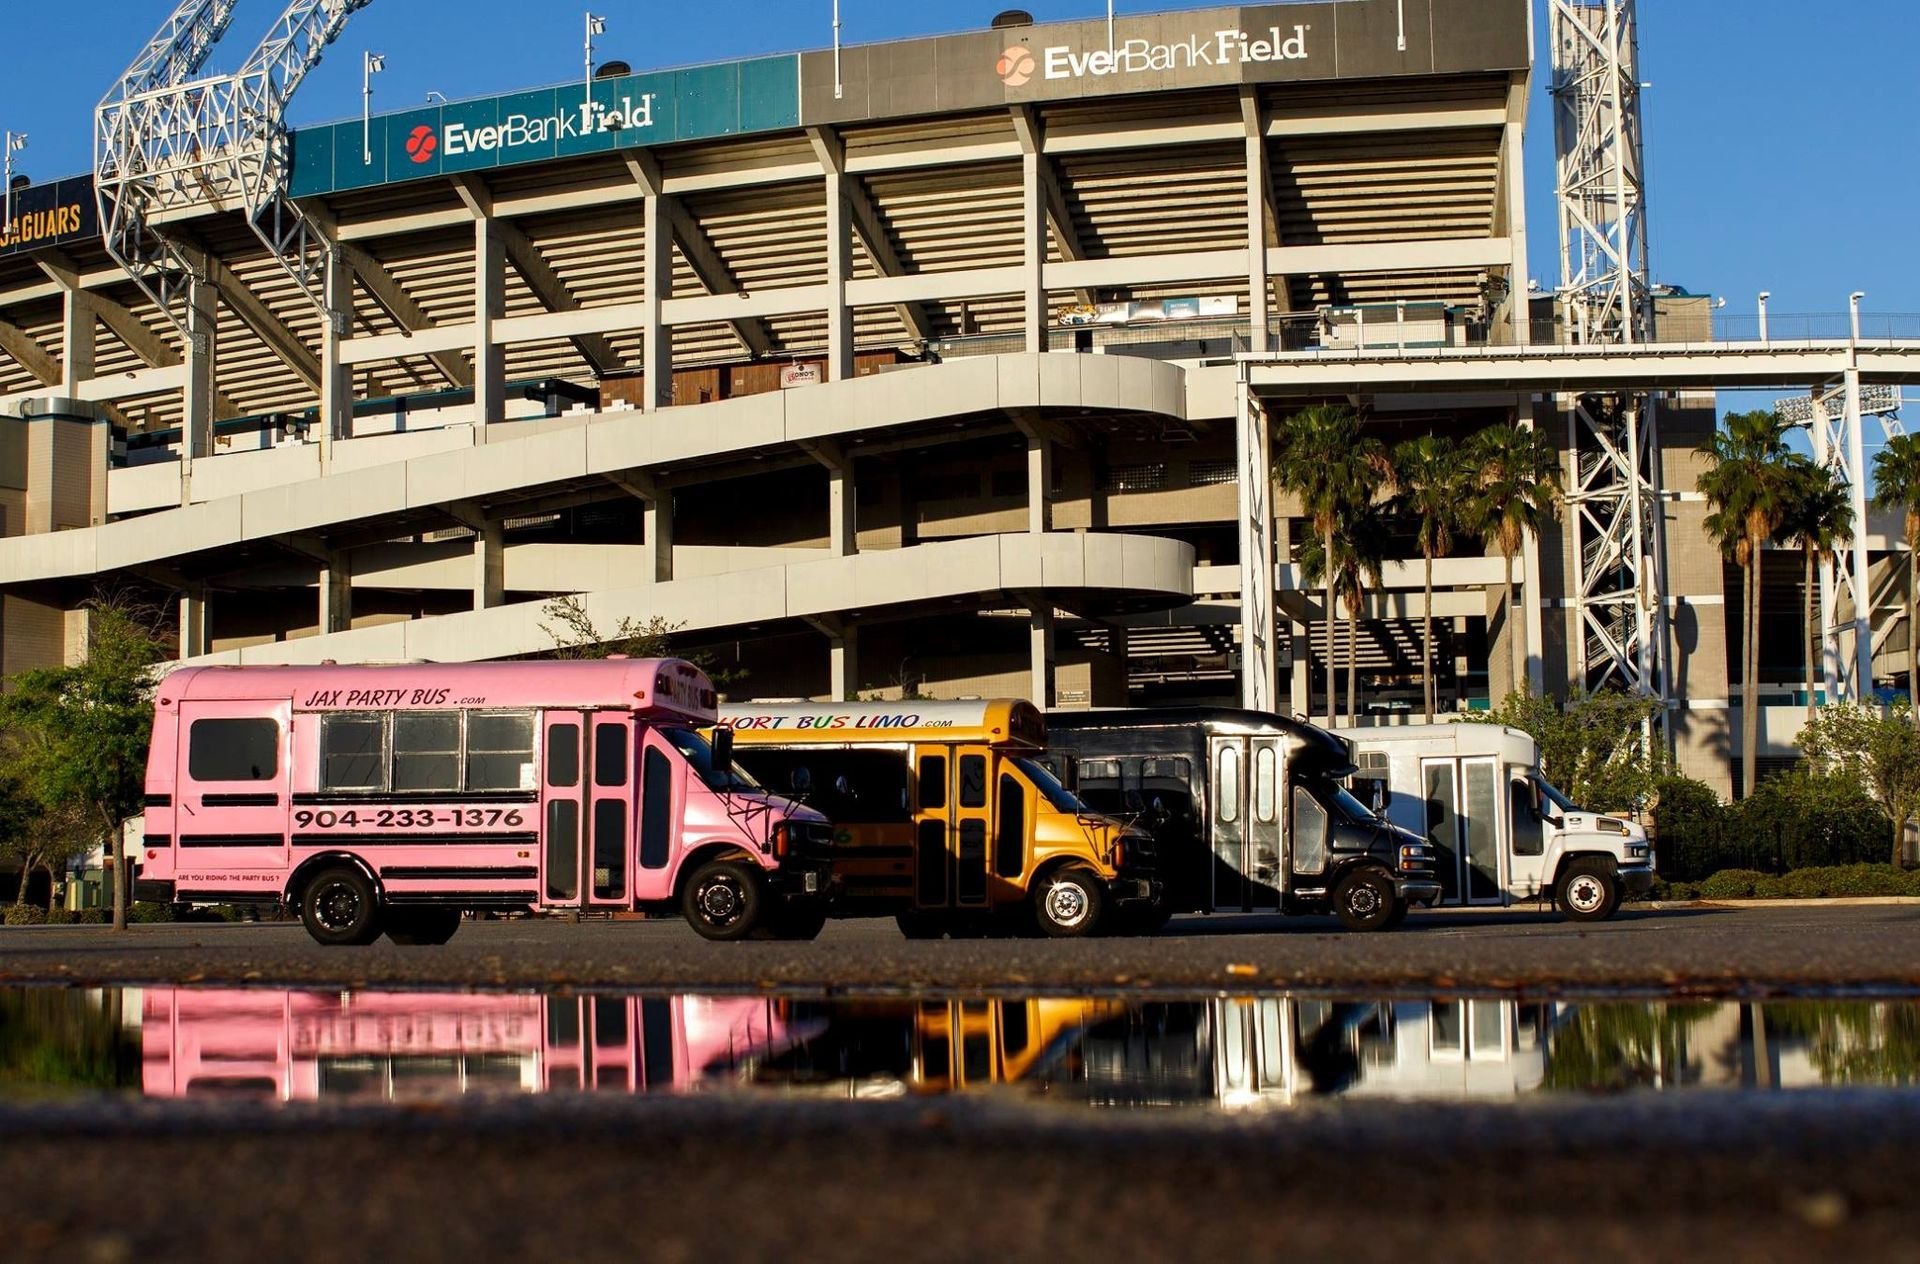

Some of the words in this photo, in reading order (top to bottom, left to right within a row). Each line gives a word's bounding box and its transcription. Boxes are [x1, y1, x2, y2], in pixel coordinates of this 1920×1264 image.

[1044, 34, 1213, 80] EverBank
[1215, 25, 1308, 65] Field
[444, 107, 578, 155] EverBank
[305, 690, 342, 706] JAX
[346, 689, 407, 706] PARTY
[410, 688, 450, 705] BUS
[796, 715, 851, 730] BUS
[855, 714, 920, 729] LIMO
[294, 808, 524, 828] 904-233-1376
